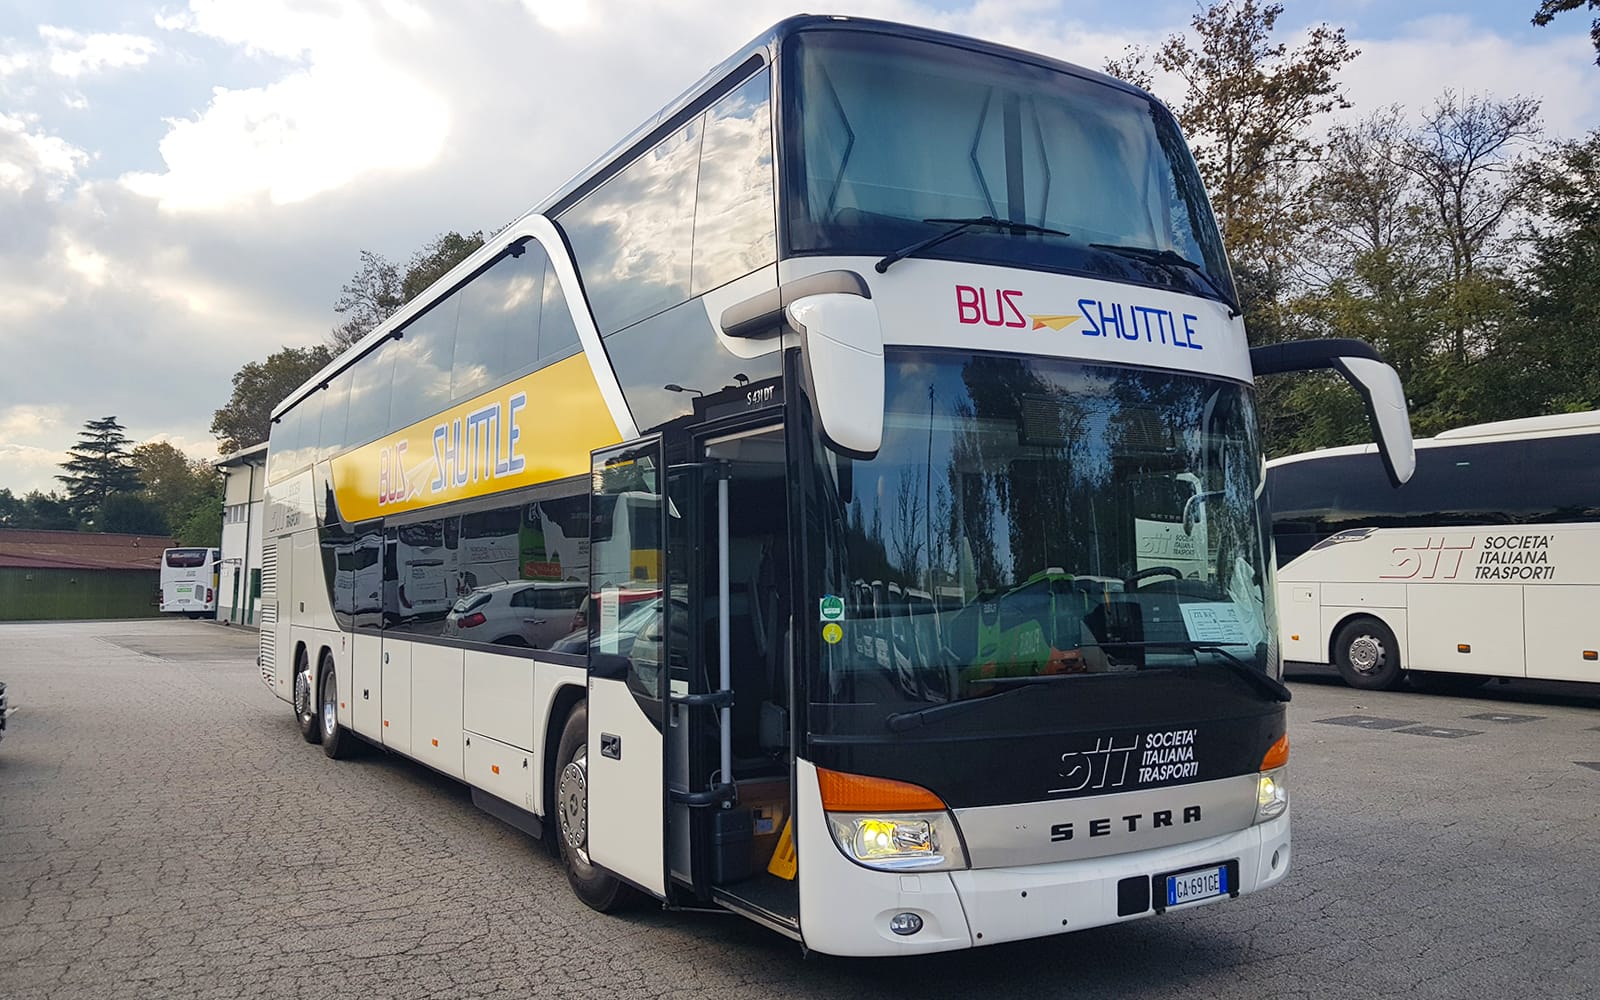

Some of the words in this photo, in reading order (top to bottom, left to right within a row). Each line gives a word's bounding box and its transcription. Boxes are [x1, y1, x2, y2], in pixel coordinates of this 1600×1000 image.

[955, 284, 1027, 329] BUS
[1077, 298, 1204, 350] SHUTTLE
[378, 440, 409, 507] BUS
[430, 391, 527, 493] SHUTTLE
[1479, 551, 1549, 564] ITALIANA
[1474, 566, 1556, 580] TRASPORTI
[1142, 746, 1194, 766] ITALIANA
[1138, 761, 1199, 783] TRASPORTI
[1050, 805, 1202, 842] SETRA
